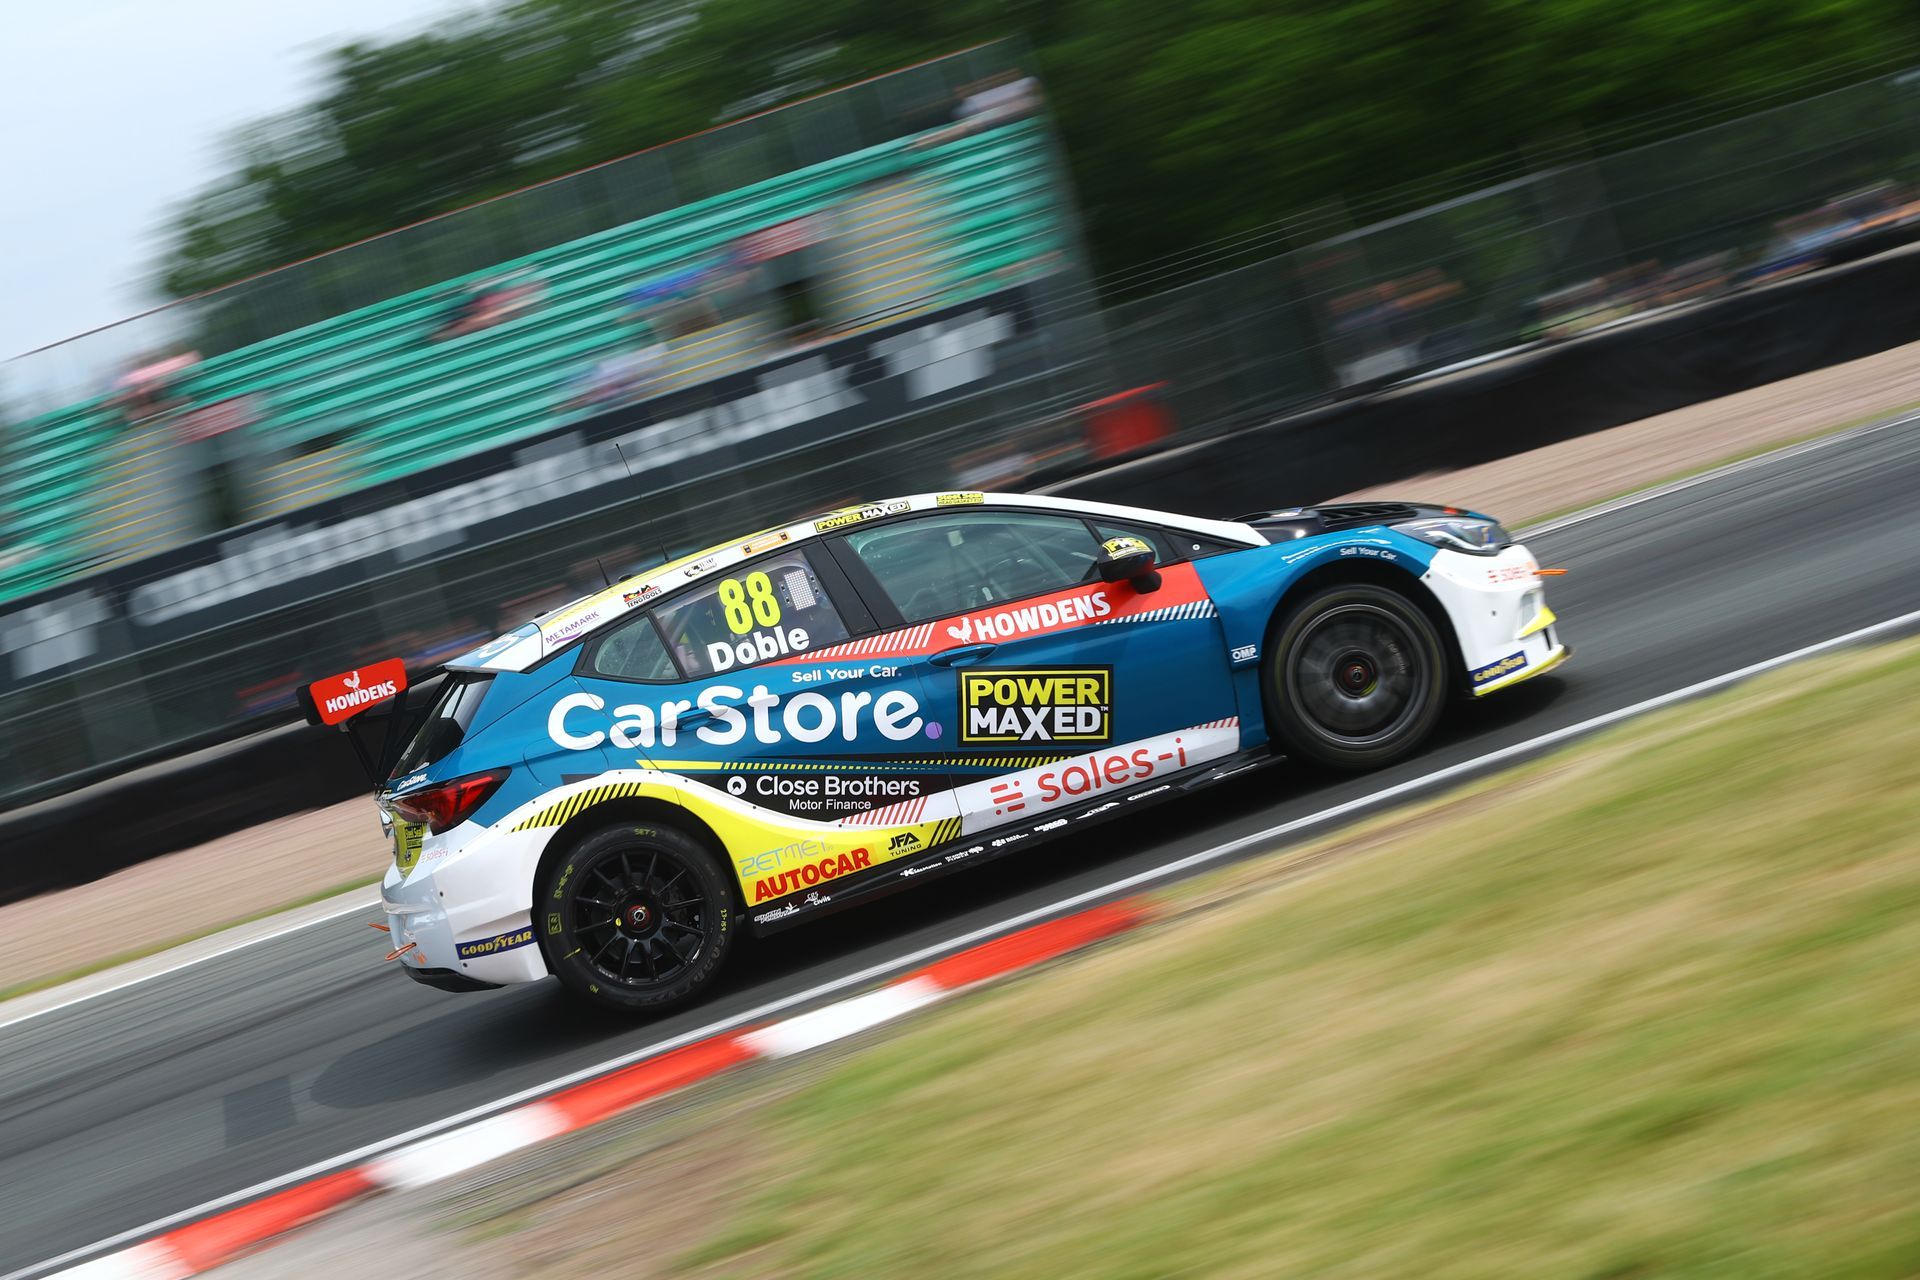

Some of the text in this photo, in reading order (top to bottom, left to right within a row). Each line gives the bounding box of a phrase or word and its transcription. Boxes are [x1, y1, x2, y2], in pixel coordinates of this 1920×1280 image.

[818, 501, 908, 530] POWER MAXED
[1340, 547, 1357, 556] Sell
[1358, 547, 1379, 556] Your
[718, 571, 782, 635] 88
[975, 592, 1111, 641] HOWDENS
[545, 611, 600, 644] METAMARK
[707, 626, 811, 672] Doble
[1232, 647, 1257, 660] OMP
[791, 668, 822, 683] Sell
[826, 665, 864, 681] Your
[325, 680, 398, 714] HOWDENS
[969, 678, 1101, 706] POWER
[970, 706, 1101, 741] MAXED
[1037, 738, 1187, 802] sales-i
[756, 775, 920, 796] Close Brothers
[789, 799, 872, 810] Motor Finance
[888, 831, 920, 851] JFA
[890, 843, 922, 857] TUNING
[755, 847, 871, 902] AUTOCAR
[461, 929, 532, 956] GOODYEAR
